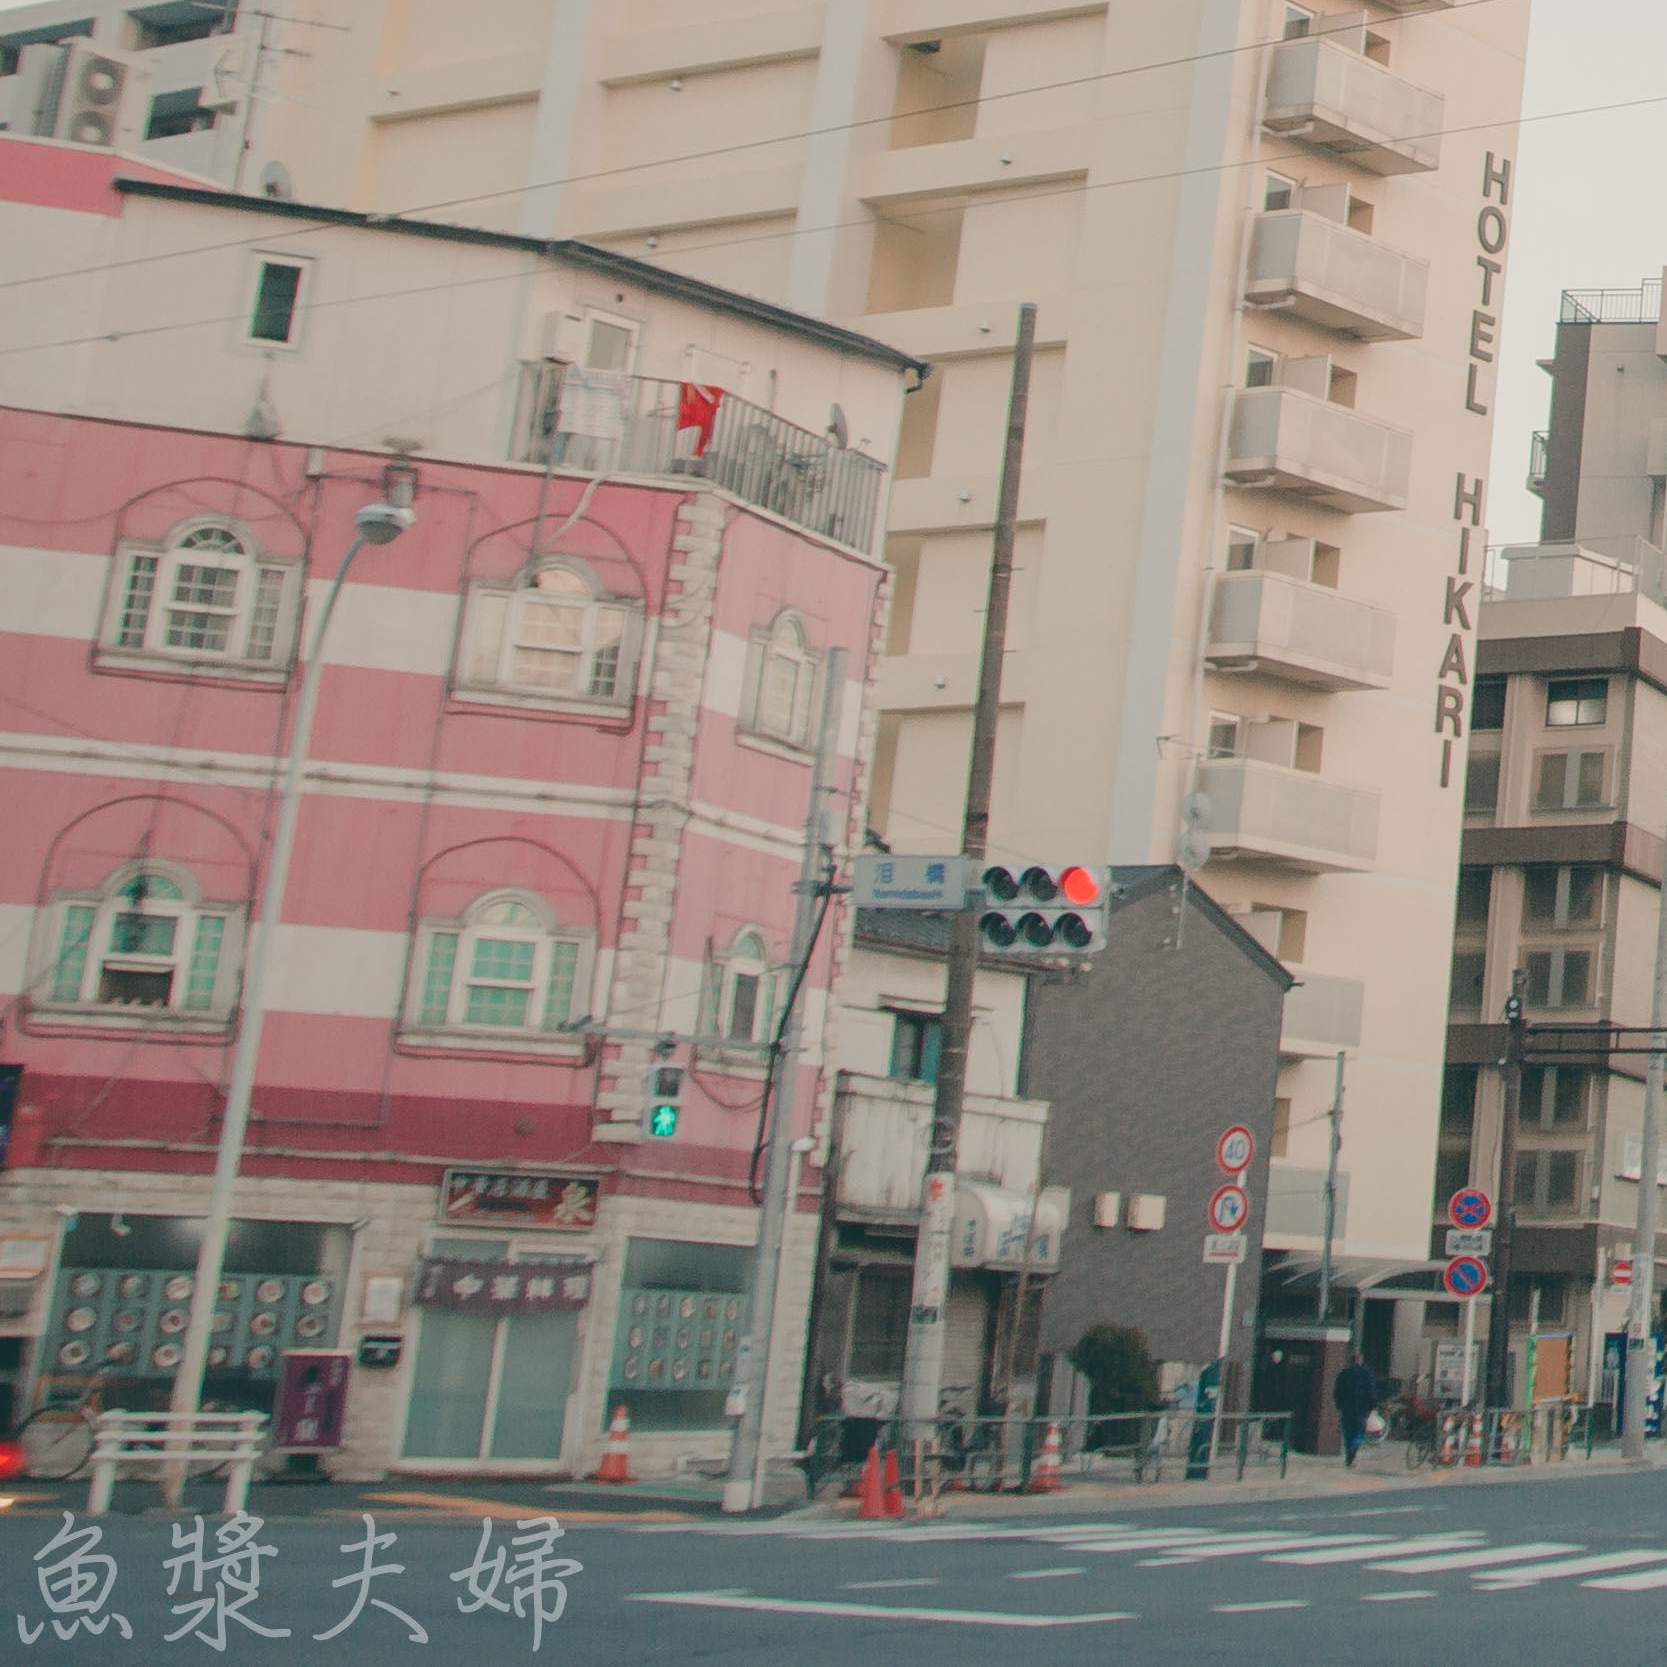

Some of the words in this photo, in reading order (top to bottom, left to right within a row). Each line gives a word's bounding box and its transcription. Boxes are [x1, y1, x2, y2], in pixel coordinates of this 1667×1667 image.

[1465, 151, 1512, 416] HOTEL
[1435, 471, 1484, 788] HIKARI
[1225, 1138, 1246, 1159] 40
